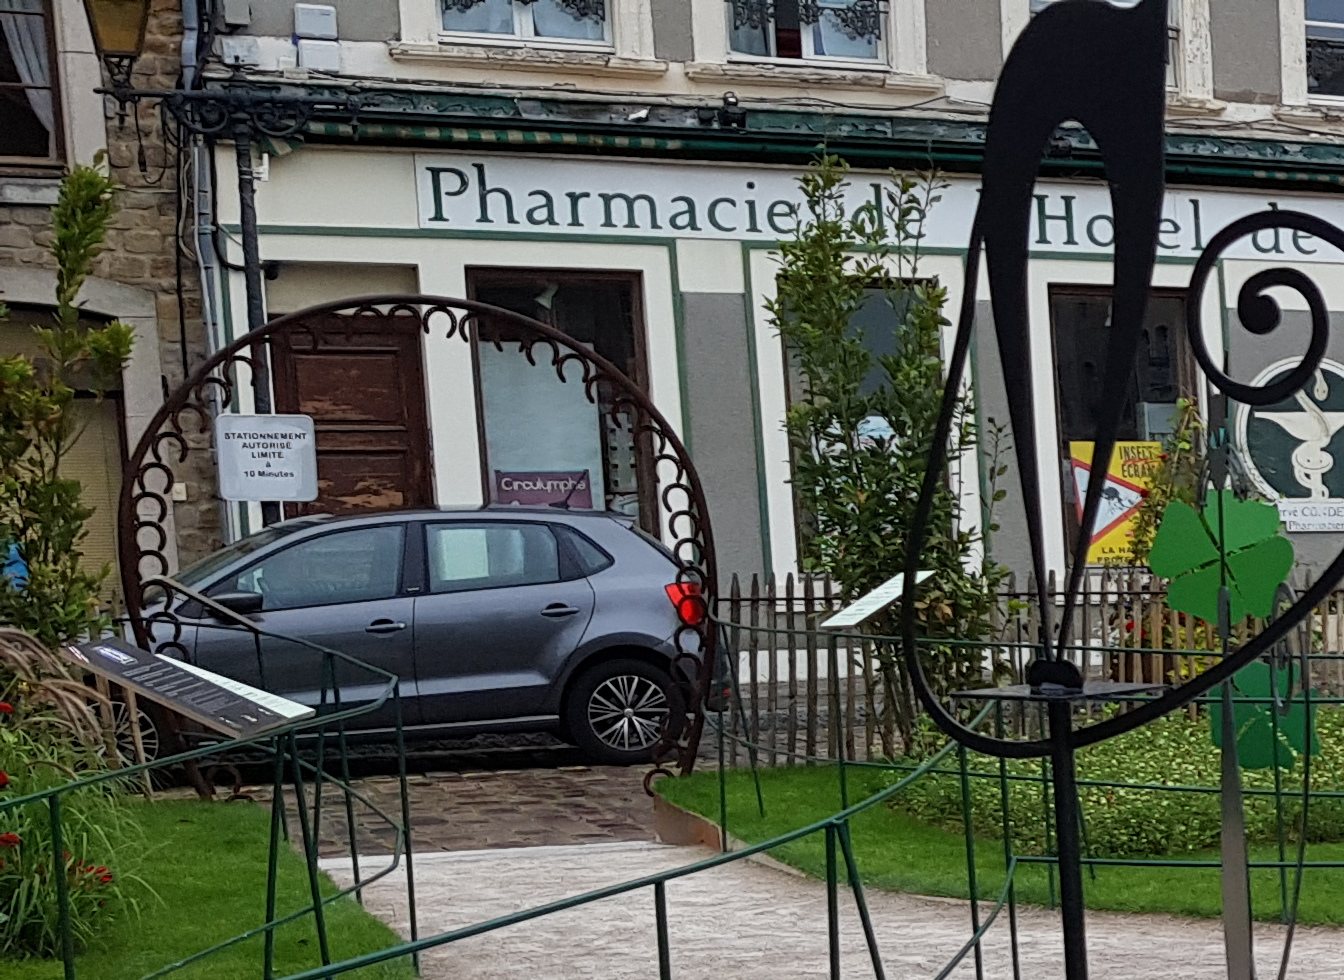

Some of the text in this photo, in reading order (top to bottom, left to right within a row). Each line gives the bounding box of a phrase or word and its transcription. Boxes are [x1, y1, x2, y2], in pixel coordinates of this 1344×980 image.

[424, 163, 800, 234] Pharmacie
[1032, 193, 1206, 252] Hoel
[224, 432, 307, 440] STATIONNEMENT
[257, 470, 295, 478] Minutes
